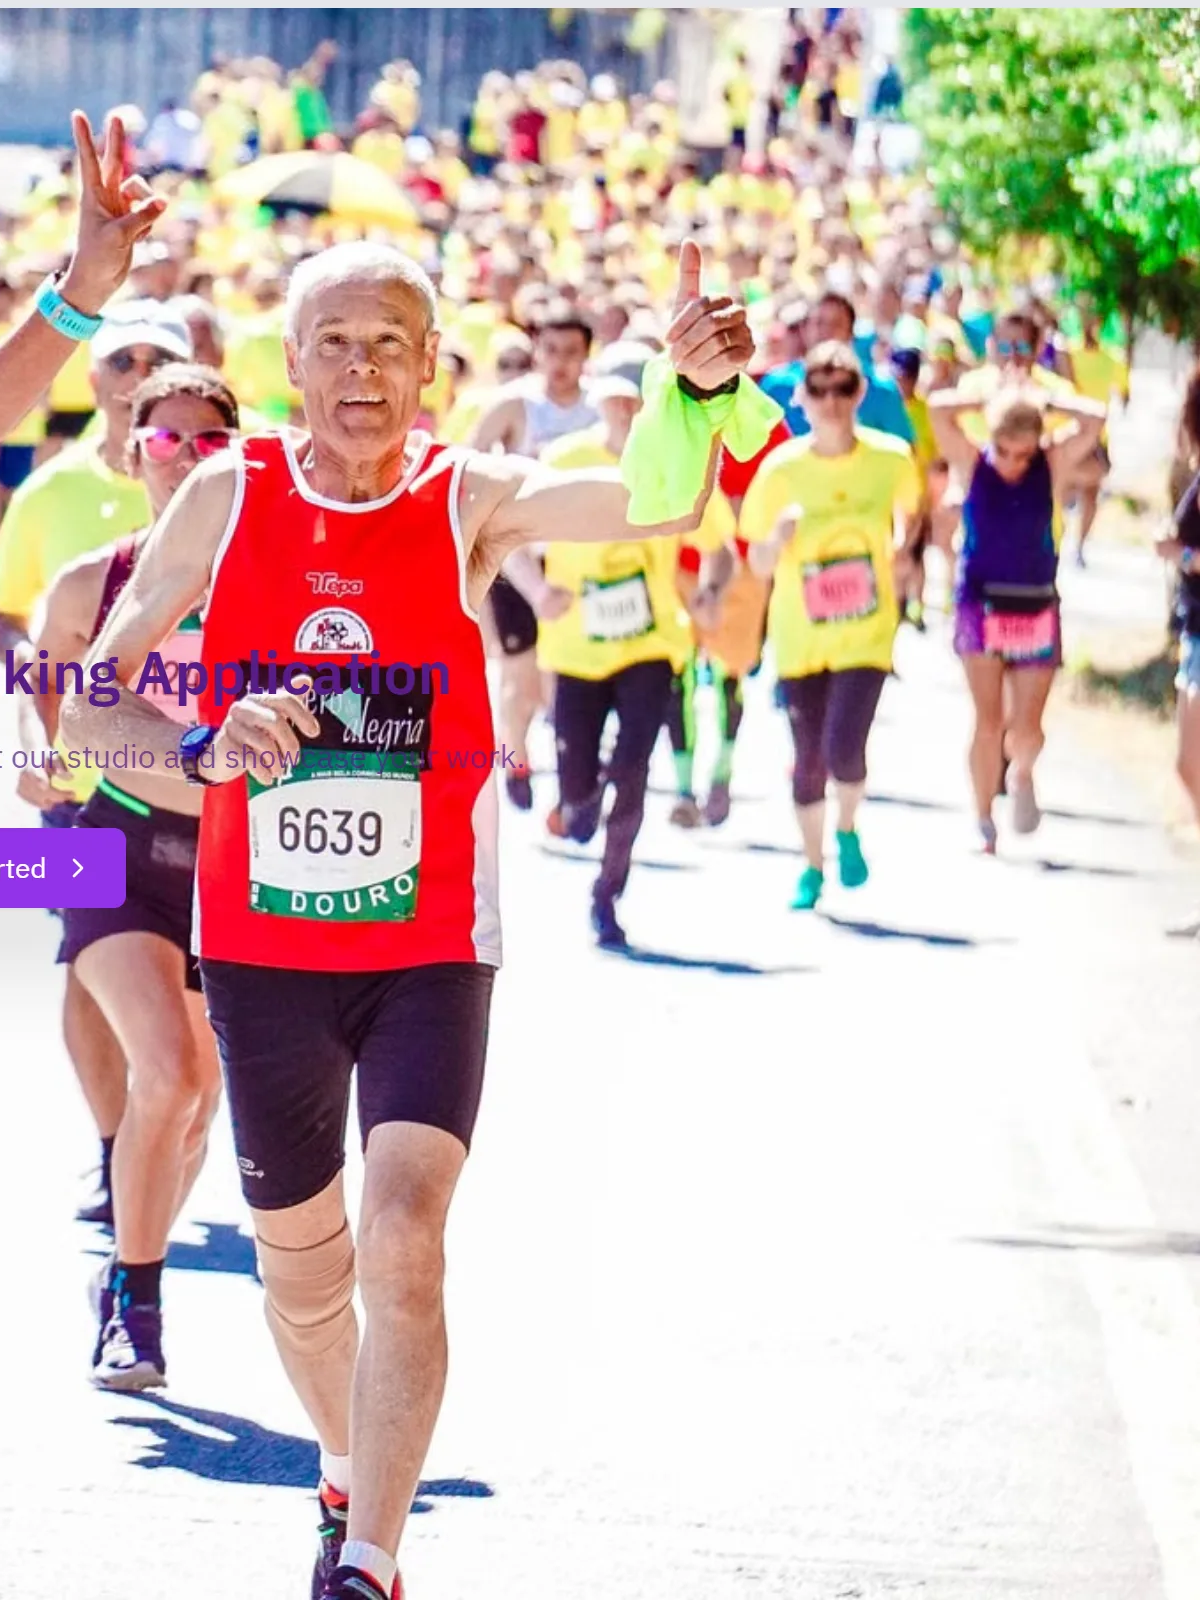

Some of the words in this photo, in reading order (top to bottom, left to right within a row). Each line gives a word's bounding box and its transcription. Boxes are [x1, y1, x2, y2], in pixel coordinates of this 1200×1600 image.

[342, 697, 425, 752] alegria
[278, 806, 383, 857] 6639
[290, 874, 415, 916] DOURO
